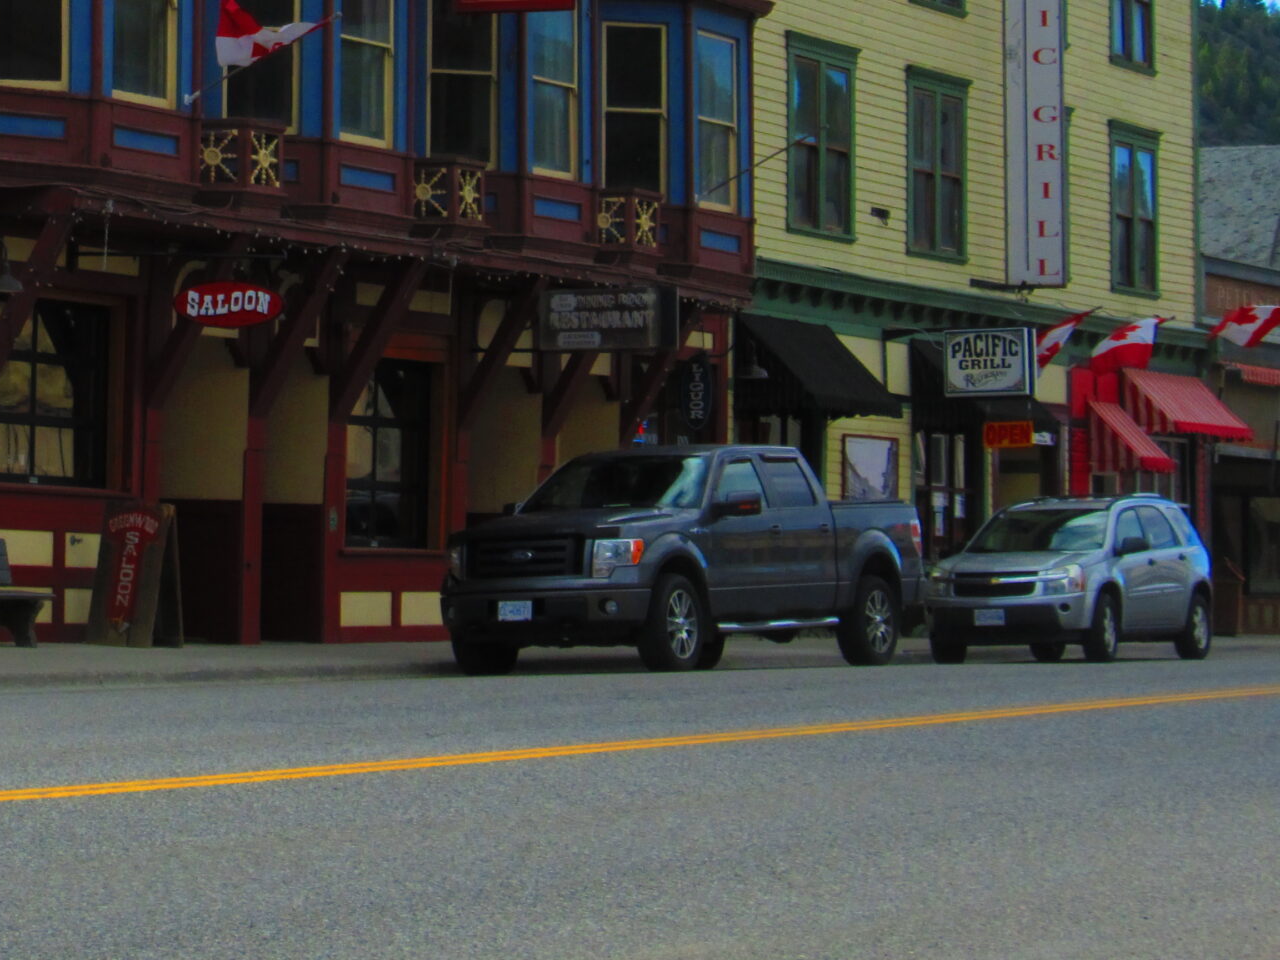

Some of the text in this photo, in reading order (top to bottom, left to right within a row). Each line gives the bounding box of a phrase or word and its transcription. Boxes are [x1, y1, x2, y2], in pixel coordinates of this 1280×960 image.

[1032, 106, 1060, 276] GRILL
[186, 290, 271, 317] SALOON
[549, 309, 656, 330] RESTAURANT
[951, 333, 1019, 359] PACIFIC
[958, 358, 1012, 371] GRILL
[688, 363, 705, 420] LIQUOR
[985, 421, 1032, 446] OPEN
[116, 531, 140, 607] SALOON
